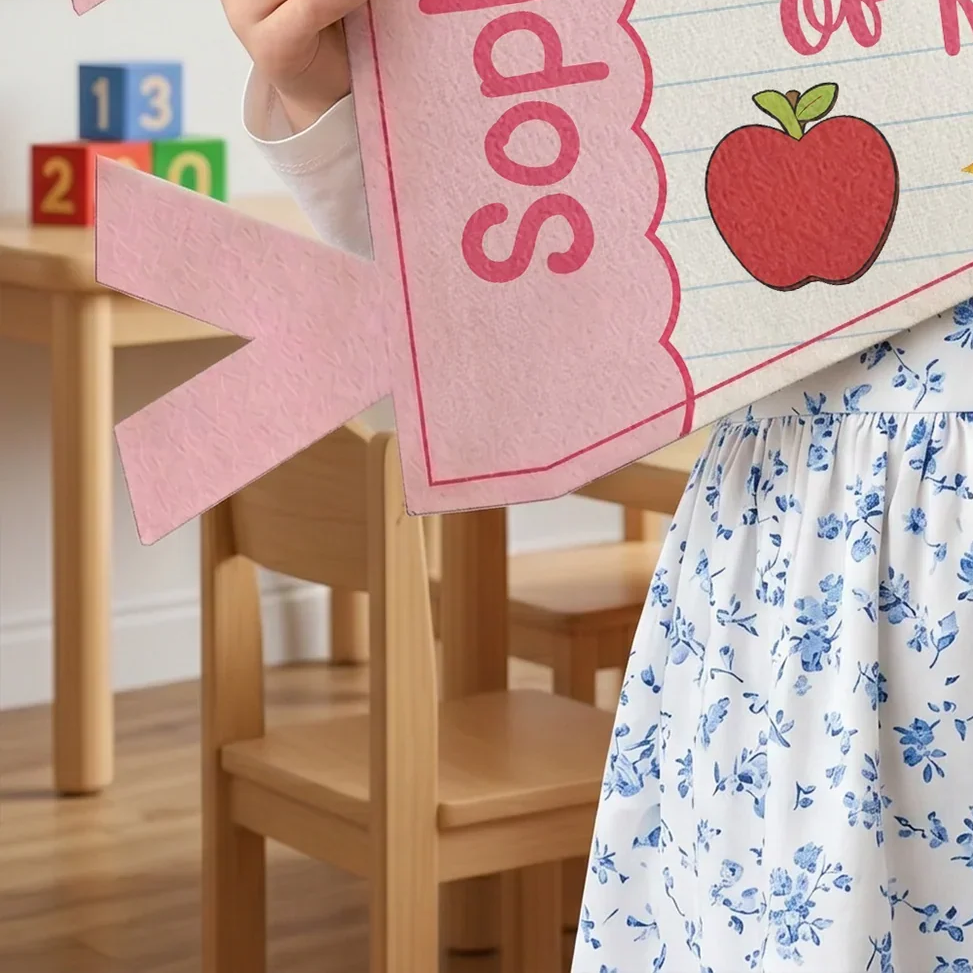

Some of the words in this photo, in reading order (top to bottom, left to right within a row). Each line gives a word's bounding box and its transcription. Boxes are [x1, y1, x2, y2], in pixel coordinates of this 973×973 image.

[91, 77, 111, 132] 1
[138, 75, 175, 132] 3
[40, 155, 76, 216] 2
